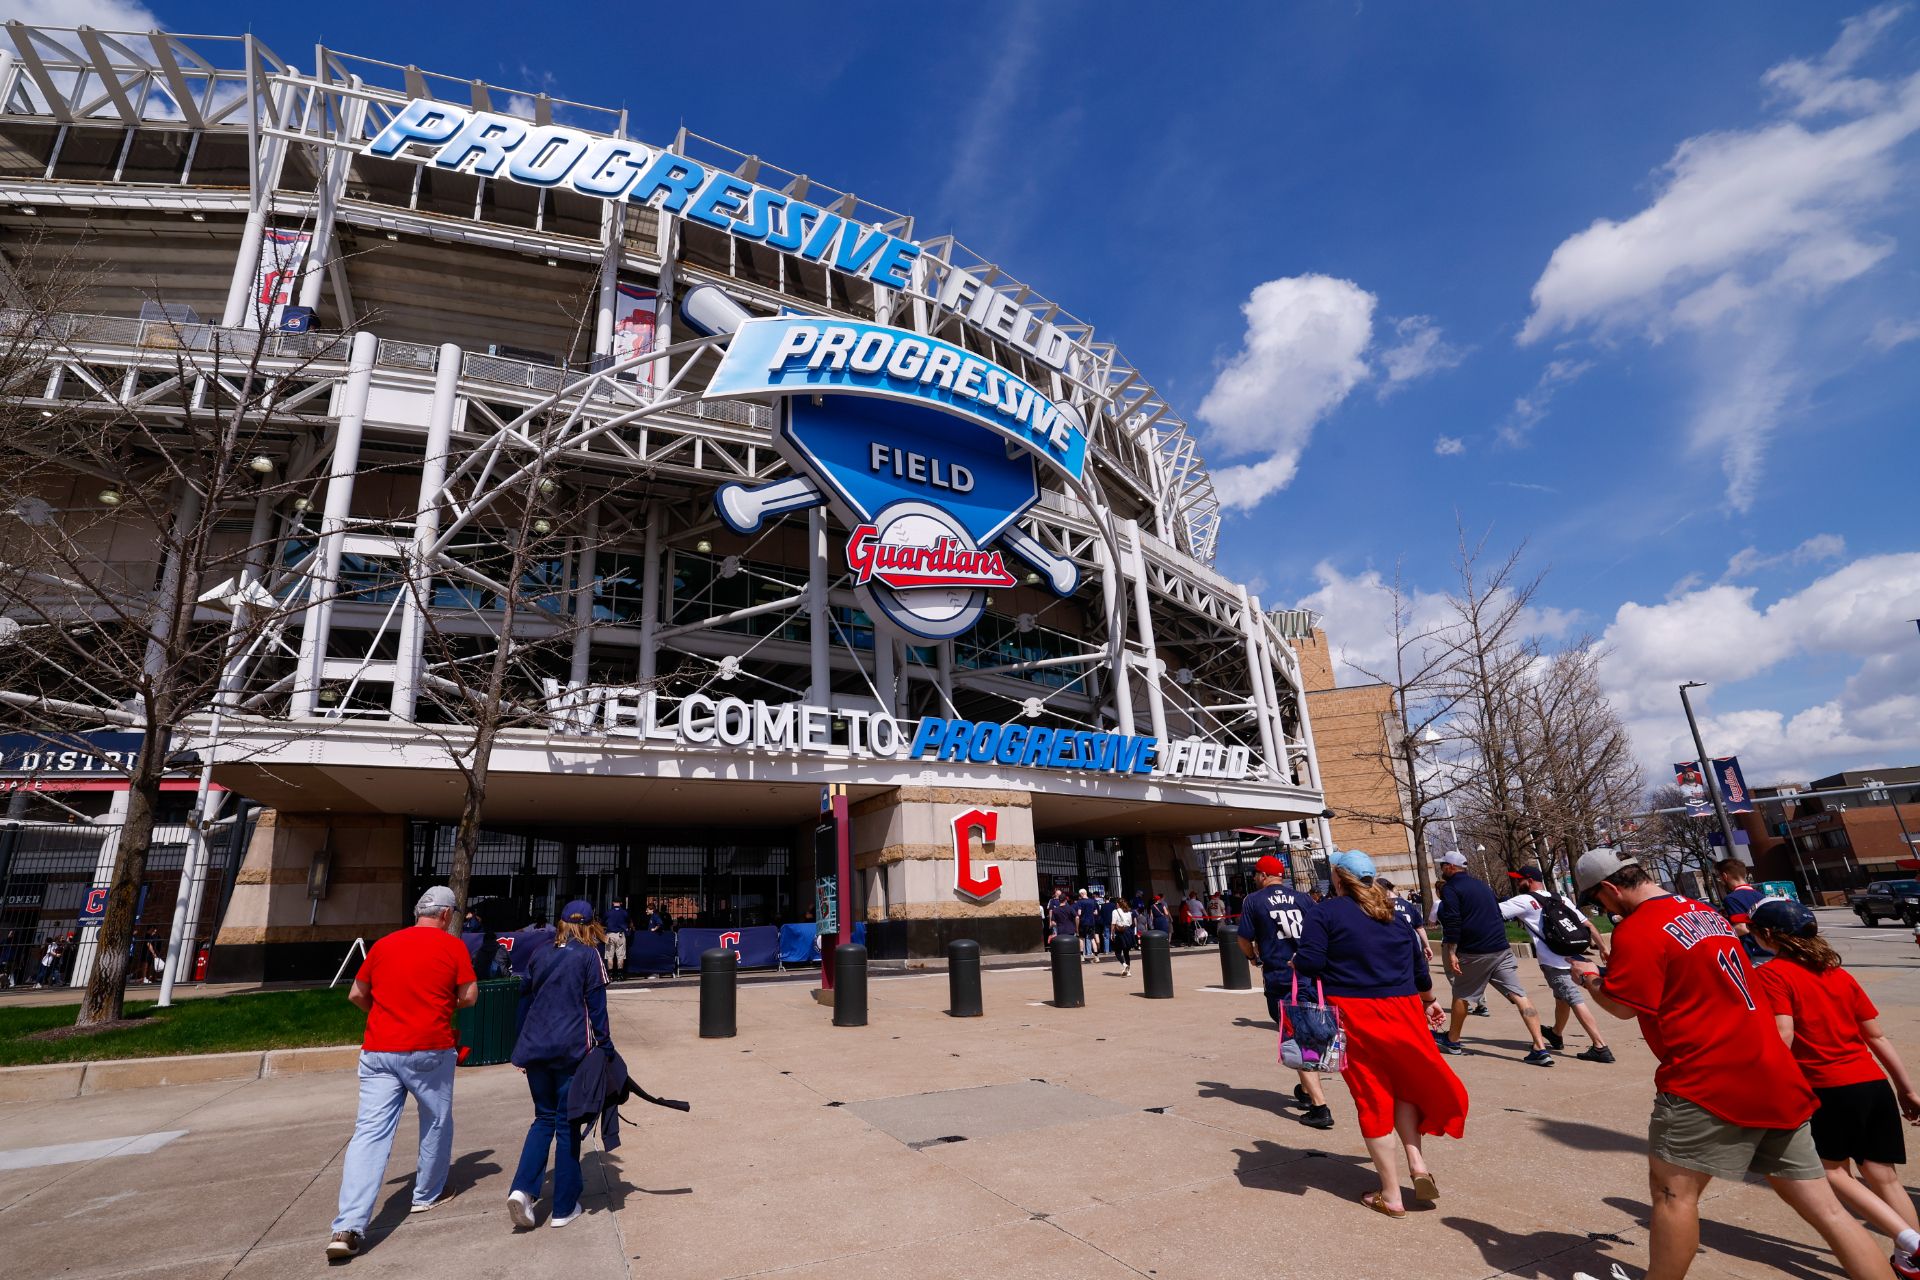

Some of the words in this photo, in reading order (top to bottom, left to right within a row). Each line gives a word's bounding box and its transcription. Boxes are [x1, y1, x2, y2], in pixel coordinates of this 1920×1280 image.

[365, 99, 920, 290] PROGRESSIVE
[942, 266, 1072, 373] FIELD
[768, 325, 1076, 454] PROGRESSIVE
[870, 441, 976, 494] FIELD
[846, 524, 1017, 588] Guardians
[542, 677, 829, 754] WELCOME
[837, 707, 899, 757] TO
[908, 716, 1159, 774] PROGRESSIVE
[1165, 740, 1250, 779] FIELD
[20, 751, 172, 771] DISTRI
[951, 807, 1003, 901] C
[85, 889, 107, 913] C
[1267, 895, 1295, 907] KWAN
[1269, 909, 1303, 940] 38
[1717, 947, 1756, 1011] 11
